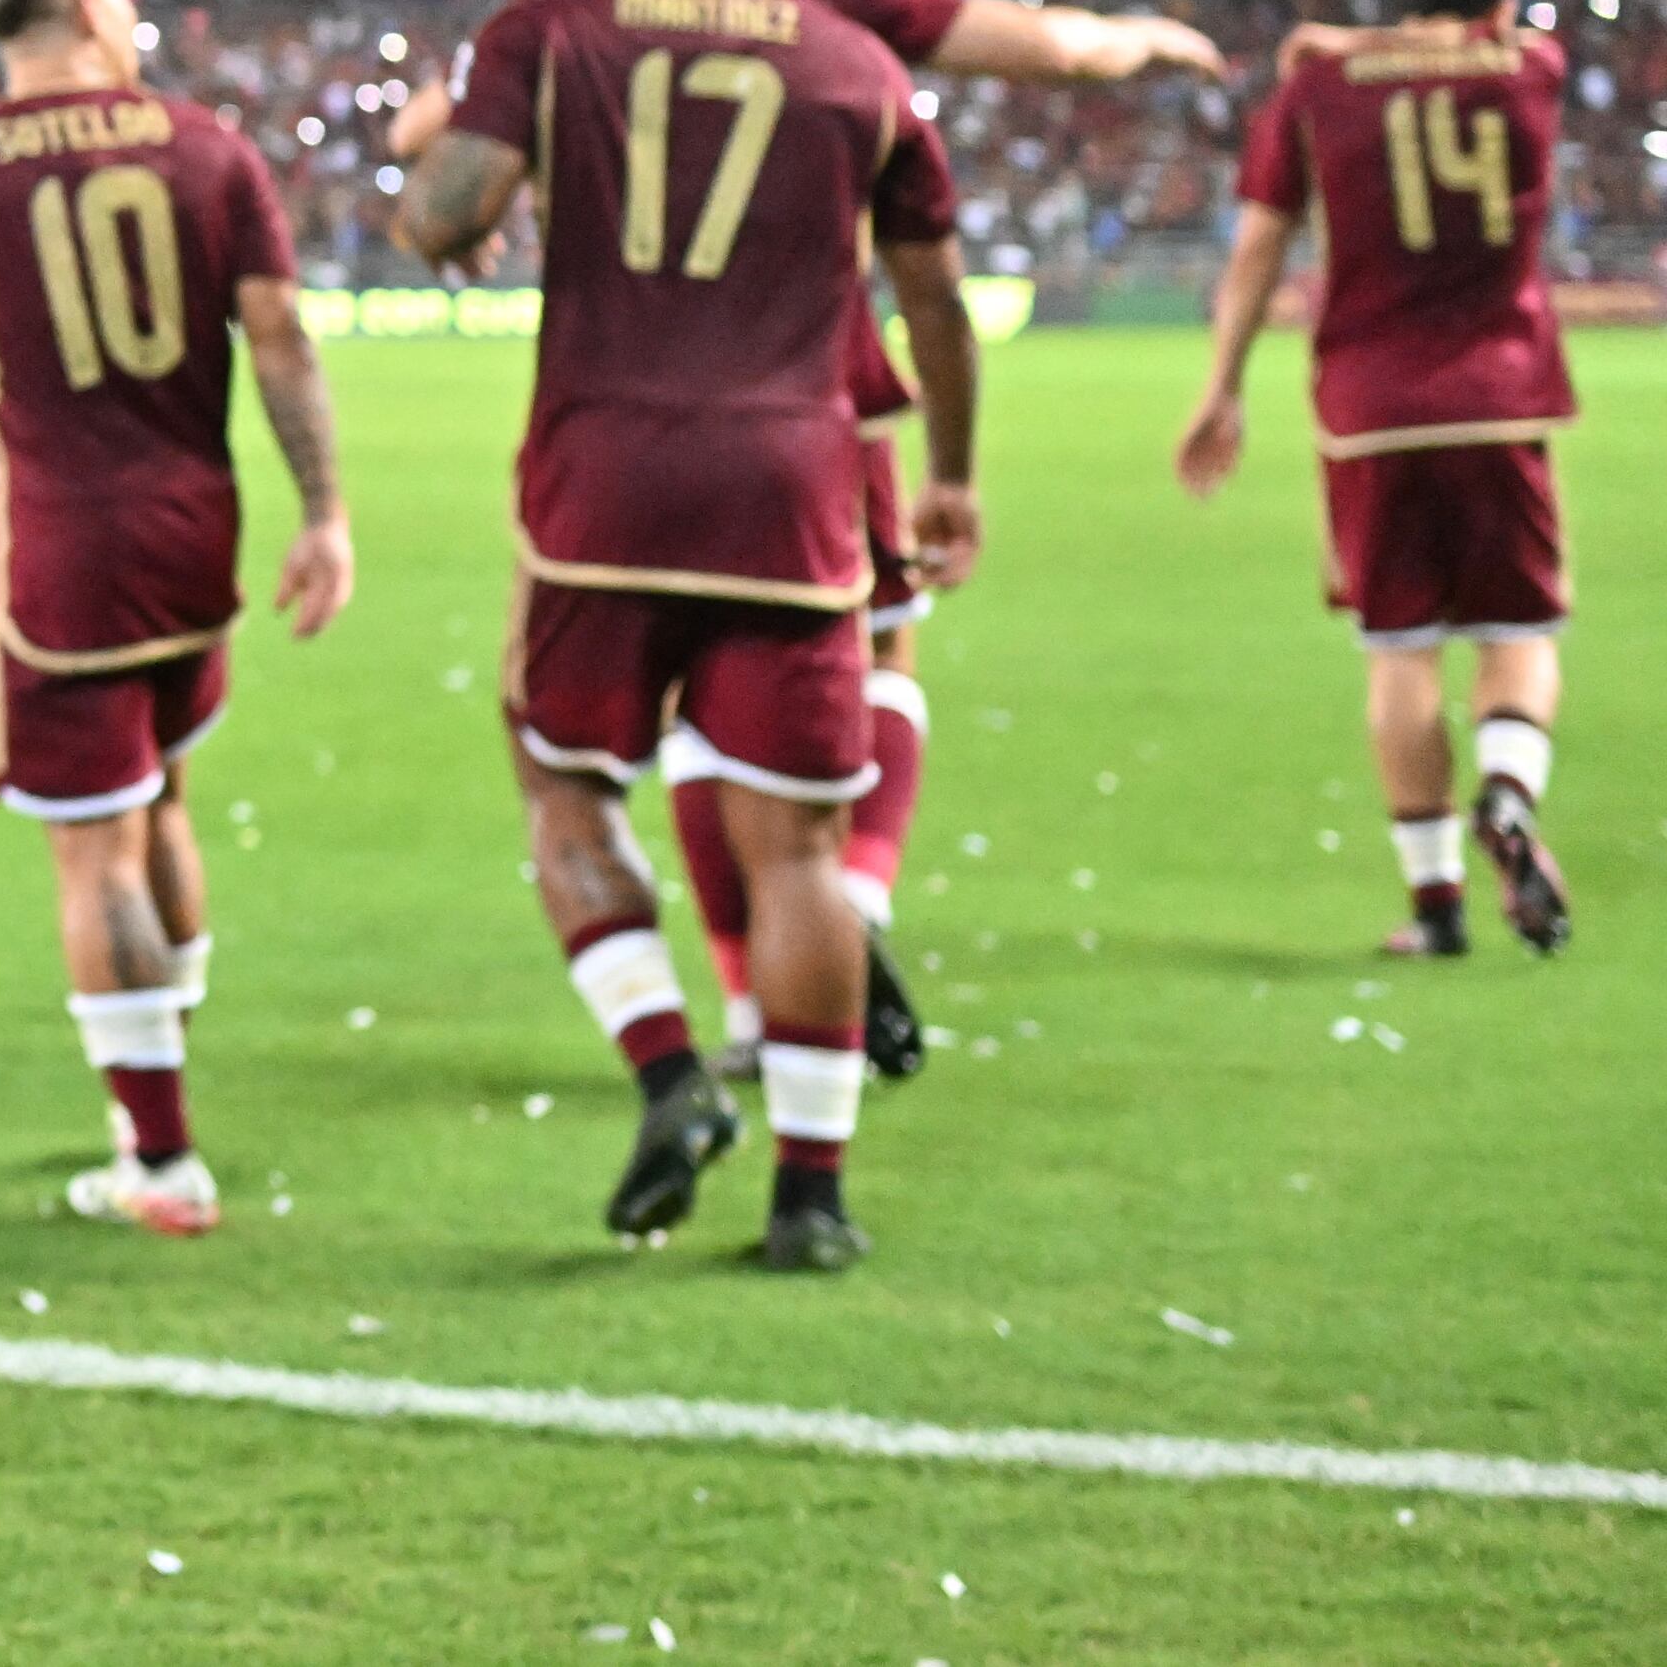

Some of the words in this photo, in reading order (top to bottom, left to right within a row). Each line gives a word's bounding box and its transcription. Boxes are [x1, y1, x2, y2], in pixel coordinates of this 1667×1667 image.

[622, 47, 787, 280] 17
[1381, 85, 1514, 254] 14
[28, 164, 187, 392] 10
